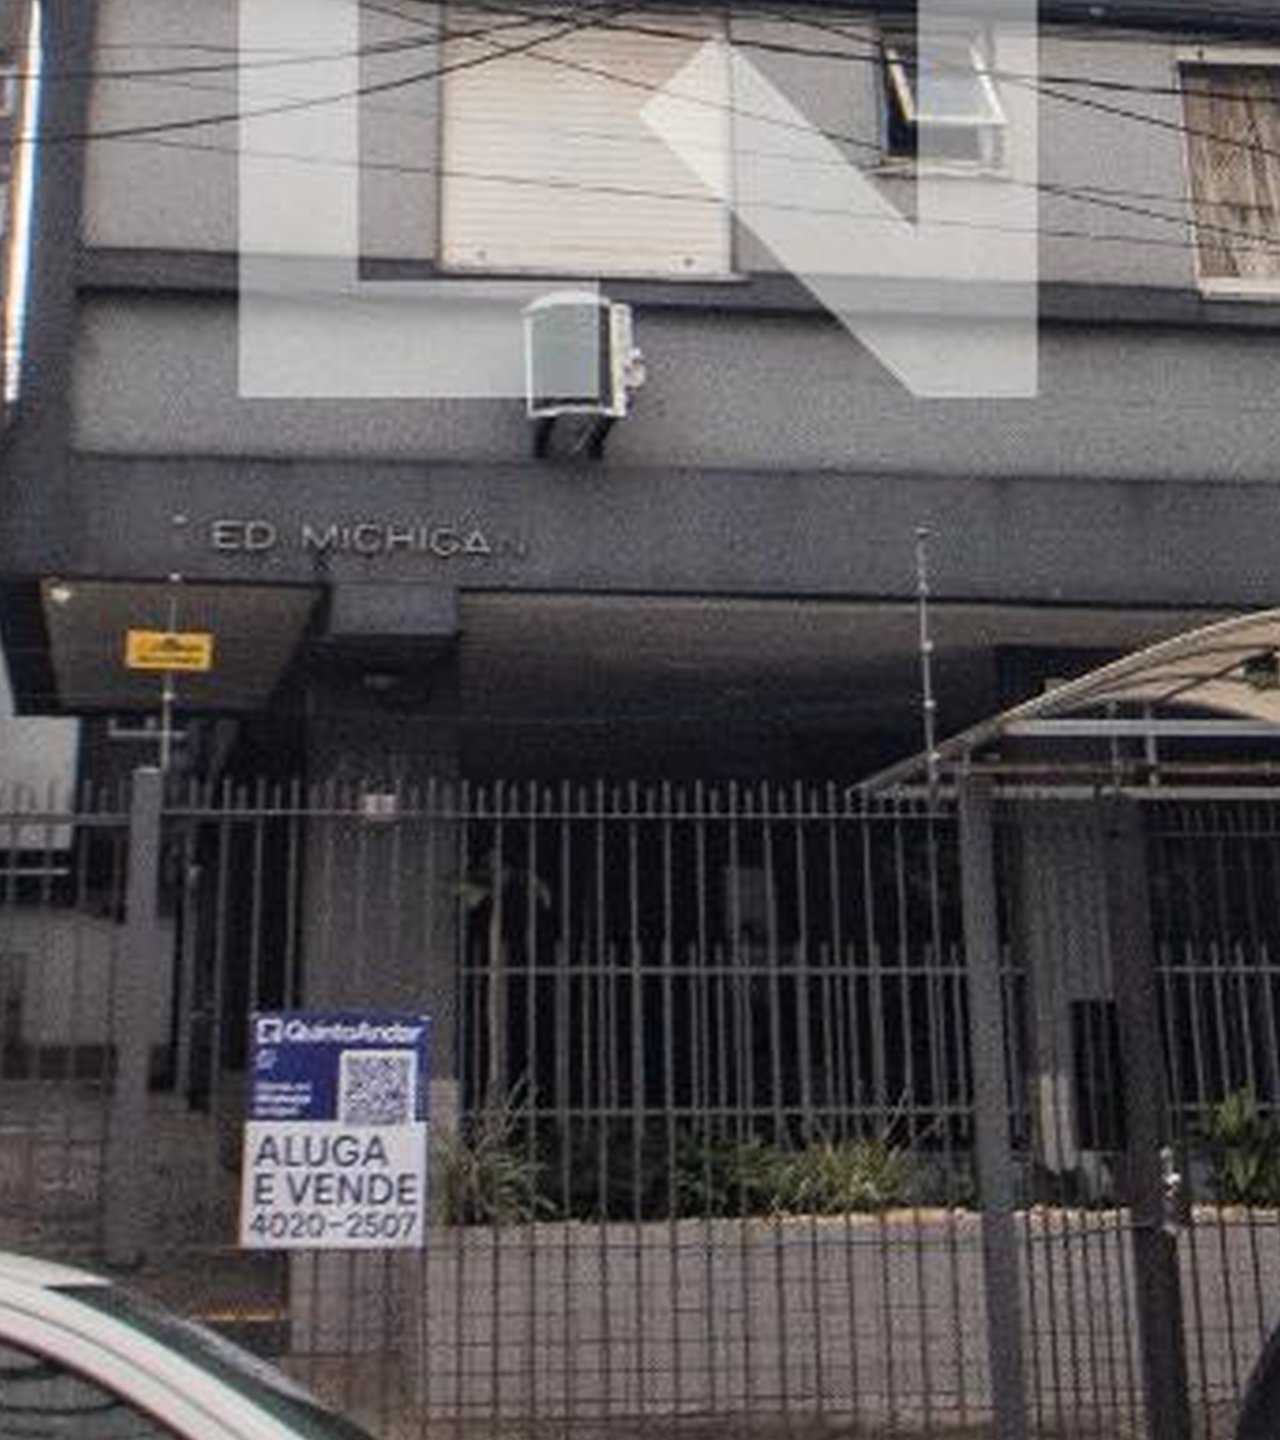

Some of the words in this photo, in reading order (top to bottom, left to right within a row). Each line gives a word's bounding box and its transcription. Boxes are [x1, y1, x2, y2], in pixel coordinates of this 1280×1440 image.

[255, 1135, 389, 1167] ALUGA
[253, 1173, 274, 1205] E
[286, 1173, 418, 1206] VENDE
[250, 1212, 418, 1239] 4020-2507
